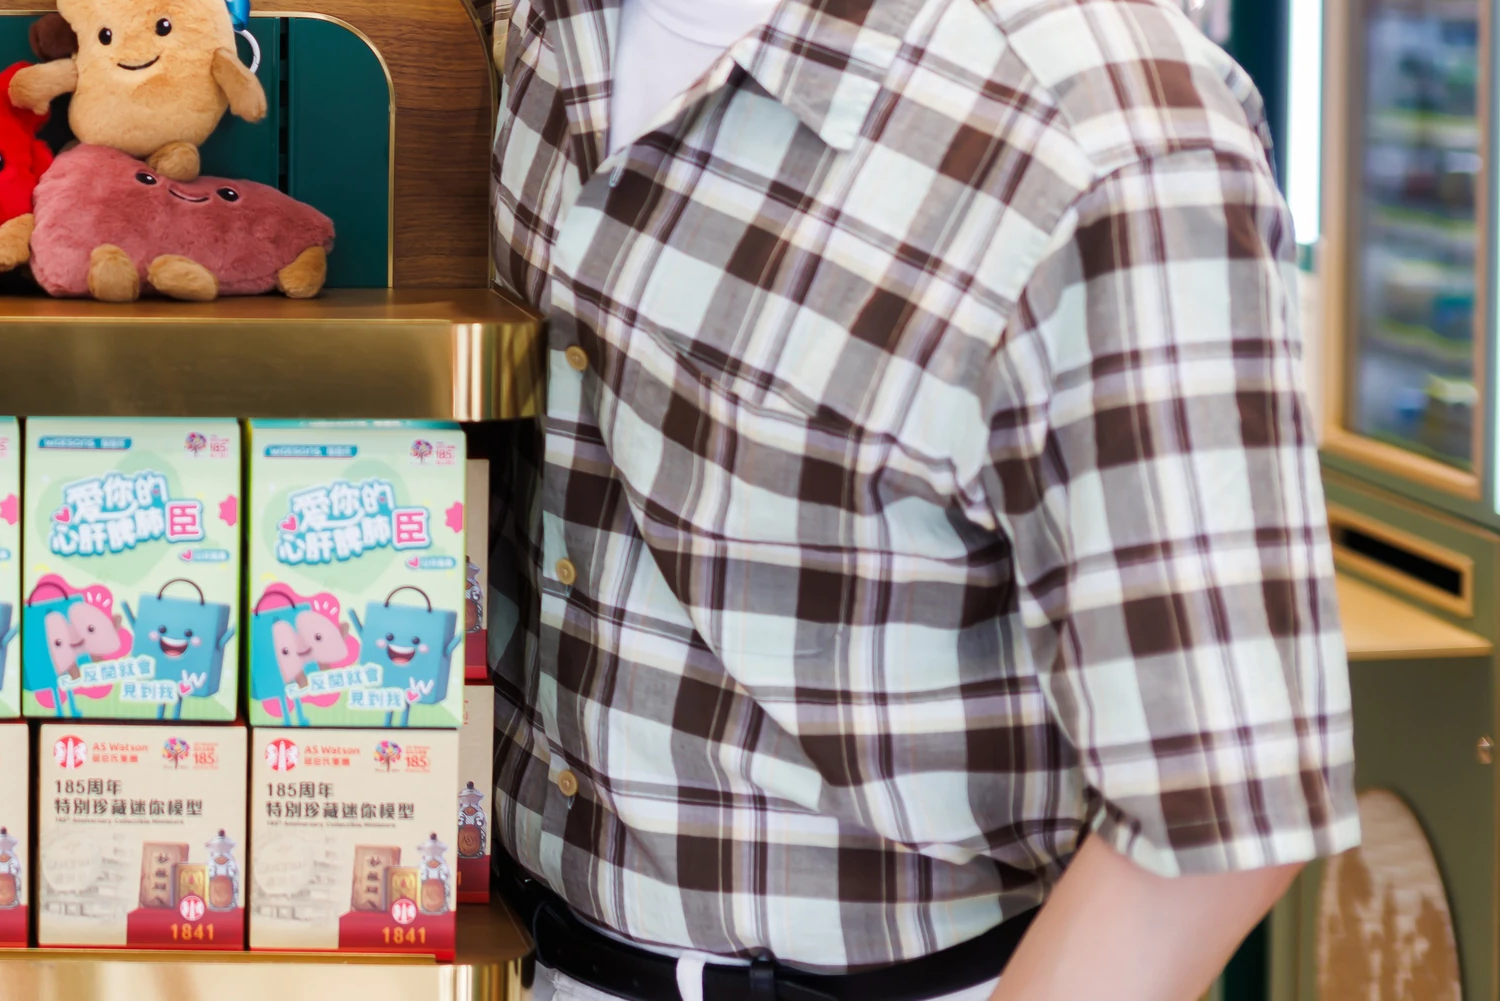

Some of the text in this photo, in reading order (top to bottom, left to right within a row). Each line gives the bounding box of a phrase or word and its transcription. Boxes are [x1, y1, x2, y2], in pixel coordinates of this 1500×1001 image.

[181, 669, 207, 688] W
[409, 676, 434, 695] W
[92, 743, 149, 752] AS Watson
[304, 745, 361, 755] AS Watson
[193, 752, 216, 764] 185
[405, 755, 428, 768] 185
[55, 779, 122, 796] 185周年
[266, 781, 334, 798] 185周年
[54, 798, 203, 816] 特別珍藏迷你模型
[266, 801, 415, 820] 特別珍藏迷你模型
[170, 923, 215, 941] 1841
[382, 926, 427, 944] 1841
